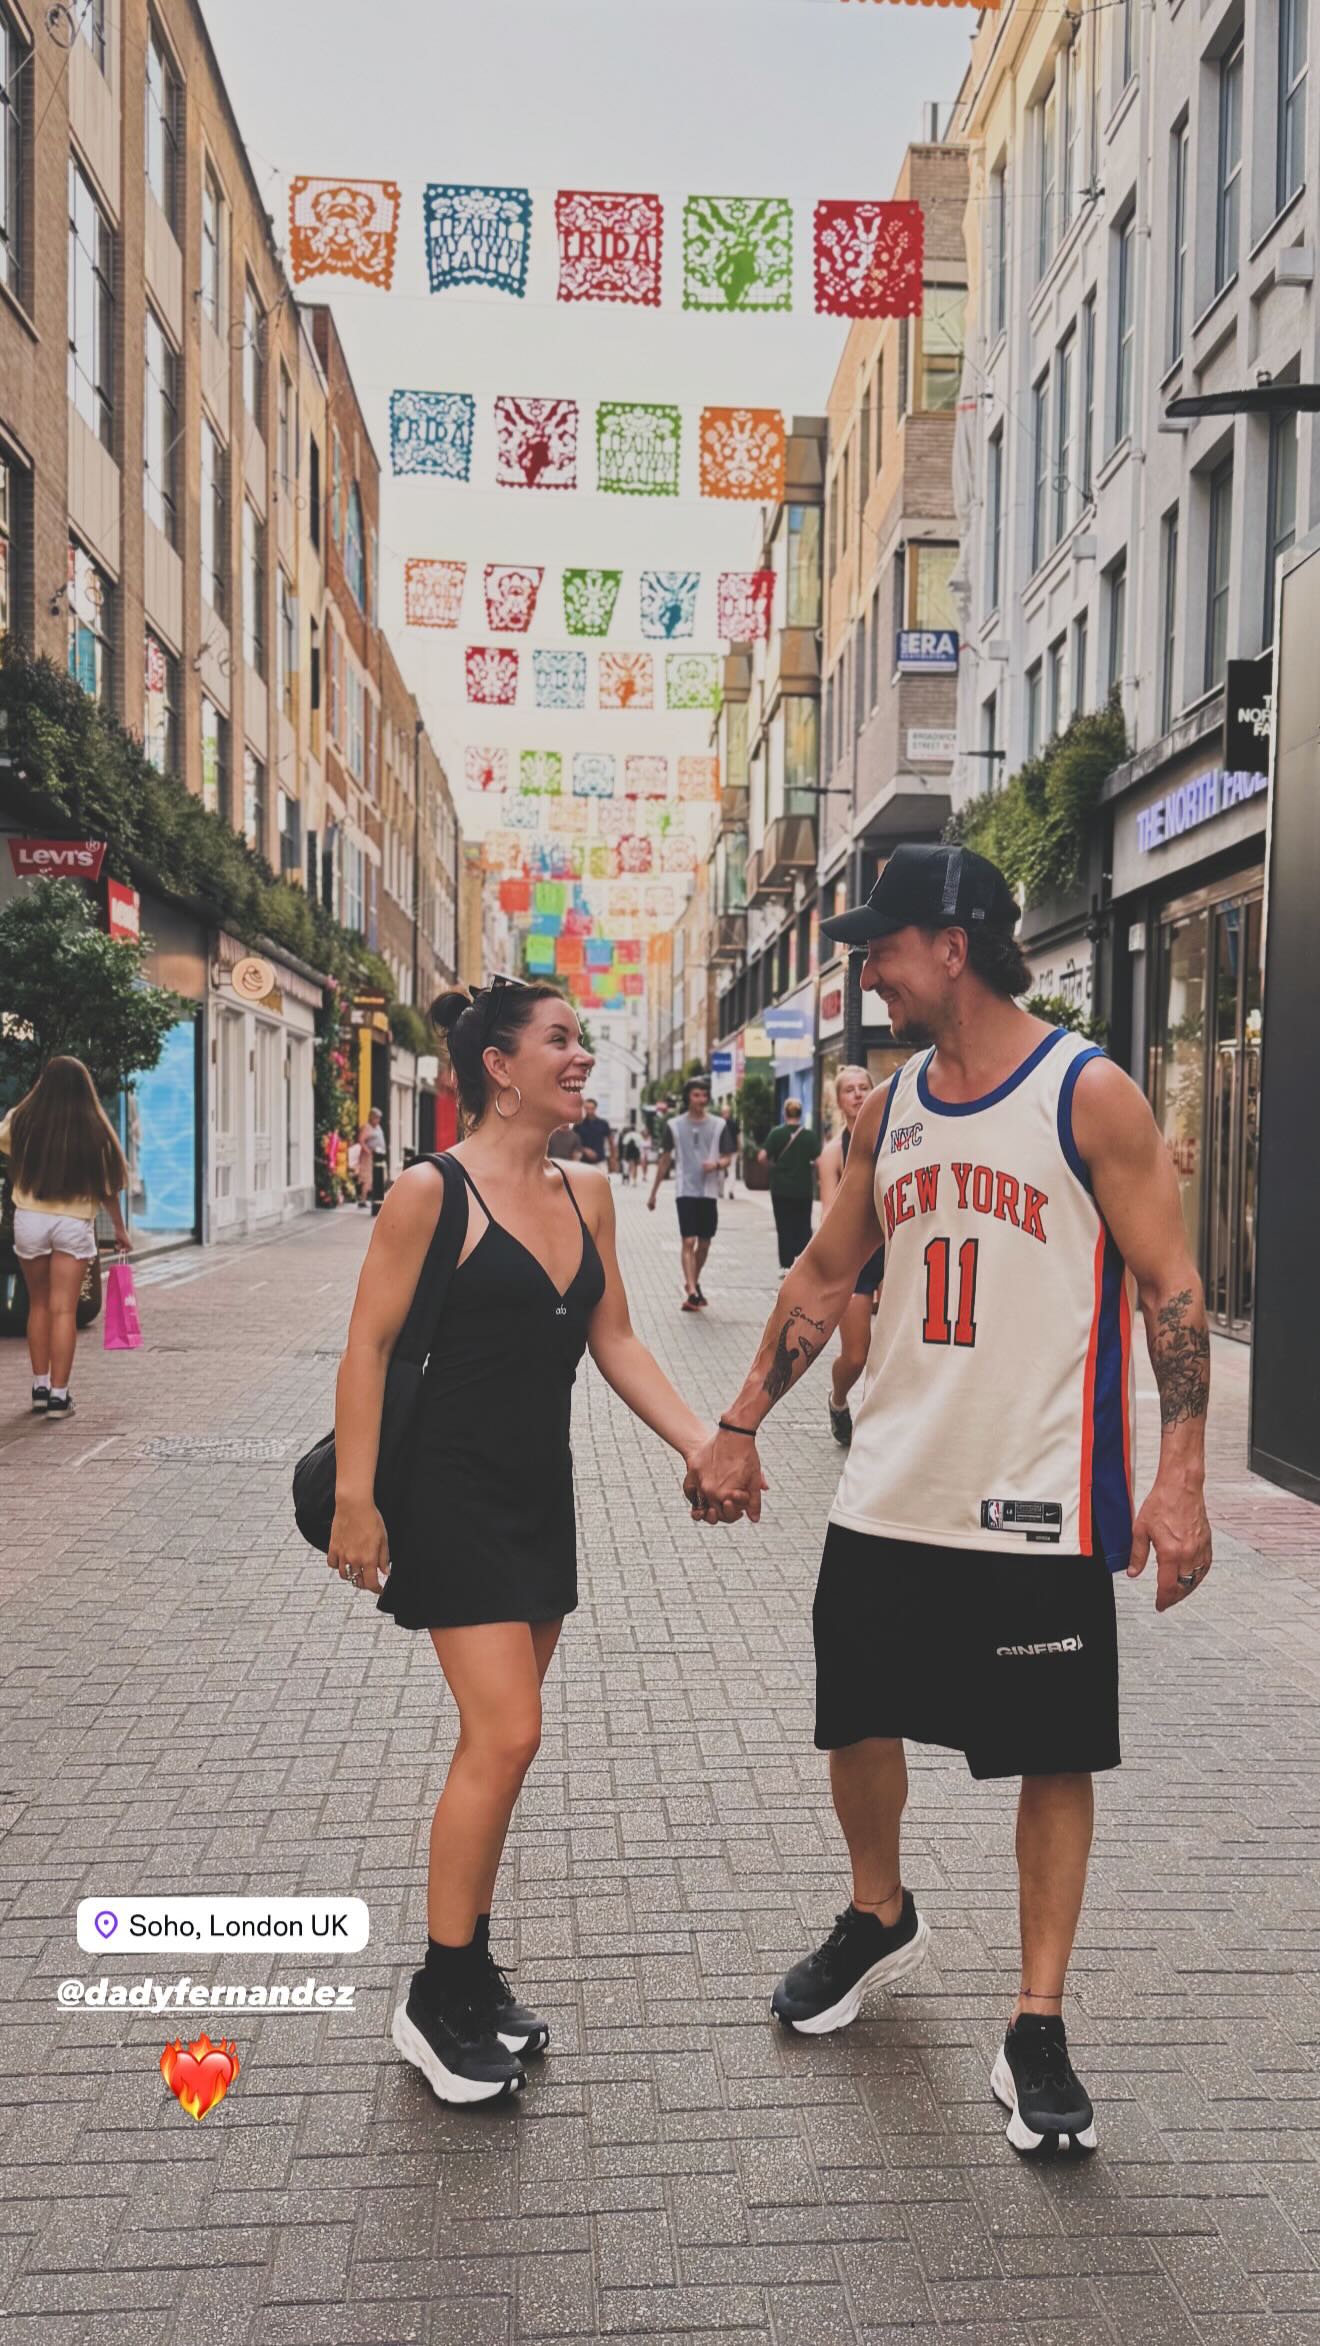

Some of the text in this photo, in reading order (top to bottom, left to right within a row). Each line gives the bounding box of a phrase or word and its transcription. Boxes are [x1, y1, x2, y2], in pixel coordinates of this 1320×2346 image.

[563, 230, 653, 264] FRIDA
[1238, 708, 1272, 723] NOR
[1253, 722, 1271, 737] FA
[1136, 800, 1166, 853] THE
[1164, 768, 1219, 841] NORTH
[890, 1122, 923, 1153] NYC
[883, 1162, 1049, 1244] NEW YORK
[922, 1236, 979, 1348] 11
